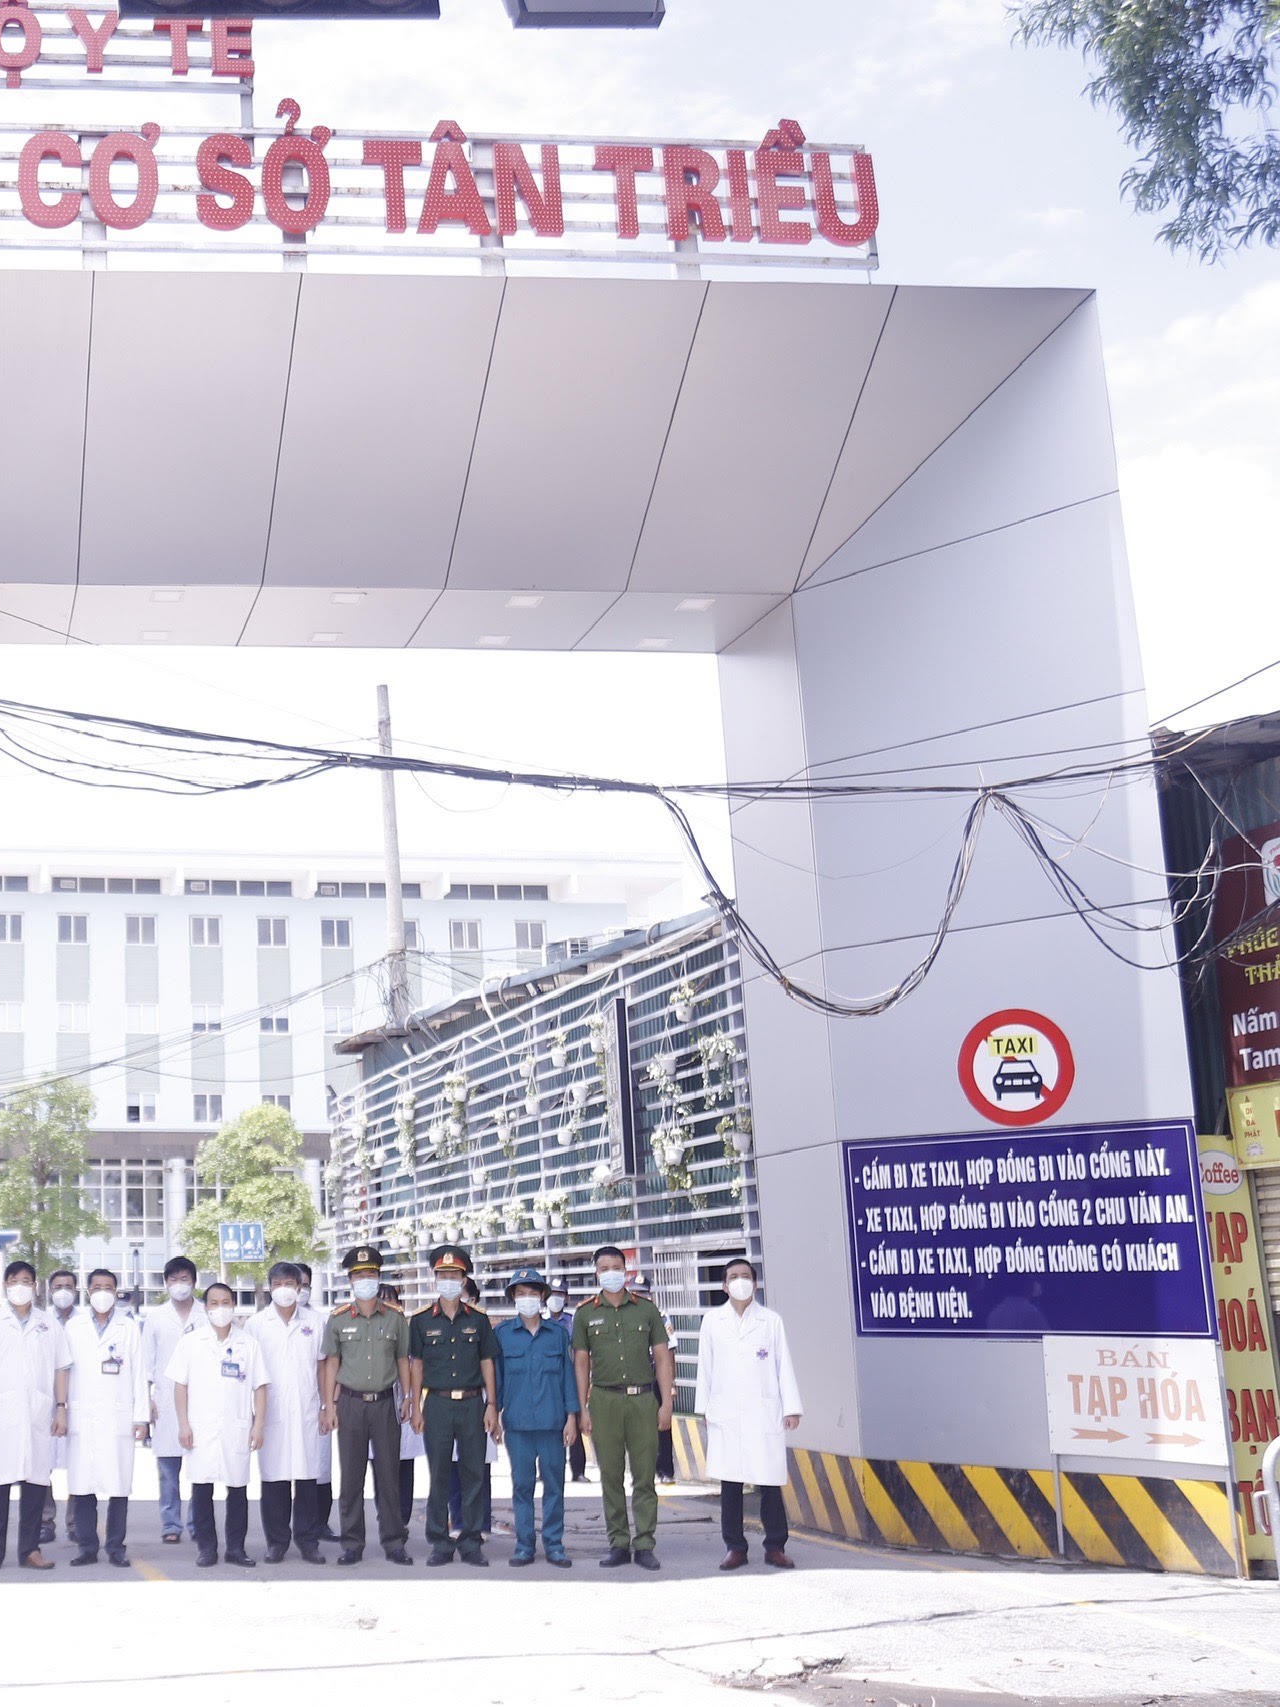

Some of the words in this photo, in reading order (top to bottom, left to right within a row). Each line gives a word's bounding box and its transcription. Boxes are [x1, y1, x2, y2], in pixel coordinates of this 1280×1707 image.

[67, 10, 119, 73] Y
[18, 121, 160, 230] CƠ
[196, 97, 331, 234] SỞ
[362, 119, 564, 237] TÂN
[594, 118, 880, 246] TRIỀU
[1232, 1005, 1278, 1038] Nấm
[993, 1037, 1034, 1054] TAXI
[862, 1156, 891, 1190] CẤM
[894, 1163, 907, 1189] ĐI
[910, 1162, 928, 1188] XE
[929, 1160, 964, 1189] TAXI,
[966, 1156, 994, 1190] HỢP
[1039, 1155, 1055, 1182] ĐI
[1057, 1148, 1086, 1180] VÀO
[1089, 1140, 1132, 1179] CỔNG
[1134, 1143, 1171, 1177] NÀY.
[865, 1207, 883, 1232] XE
[884, 1206, 918, 1234] TAXI,
[920, 1202, 946, 1236] HỢP
[990, 1202, 1005, 1229] ĐI
[1007, 1195, 1036, 1228] VÀO
[1039, 1189, 1080, 1227] CỔNG
[1082, 1198, 1093, 1225] 2
[1095, 1197, 1126, 1225] CHU
[1128, 1191, 1162, 1224] VĂN
[1166, 1195, 1194, 1223] AN.
[869, 1240, 898, 1275] CẤM
[901, 1249, 915, 1274] ĐI
[918, 1248, 935, 1274] XE
[937, 1247, 972, 1277] TAXI,
[974, 1244, 1002, 1279] HỢP
[1048, 1240, 1099, 1273] KHÔNG
[1101, 1238, 1123, 1272] CÓ
[1125, 1237, 1180, 1272] KHÁCH
[870, 1286, 896, 1318] VÀO
[899, 1286, 935, 1324] BỆNH
[937, 1286, 973, 1324] VIỆN.
[1096, 1344, 1170, 1369] BÁN
[1067, 1374, 1128, 1422] TẠP
[1137, 1371, 1206, 1422] HÓA
